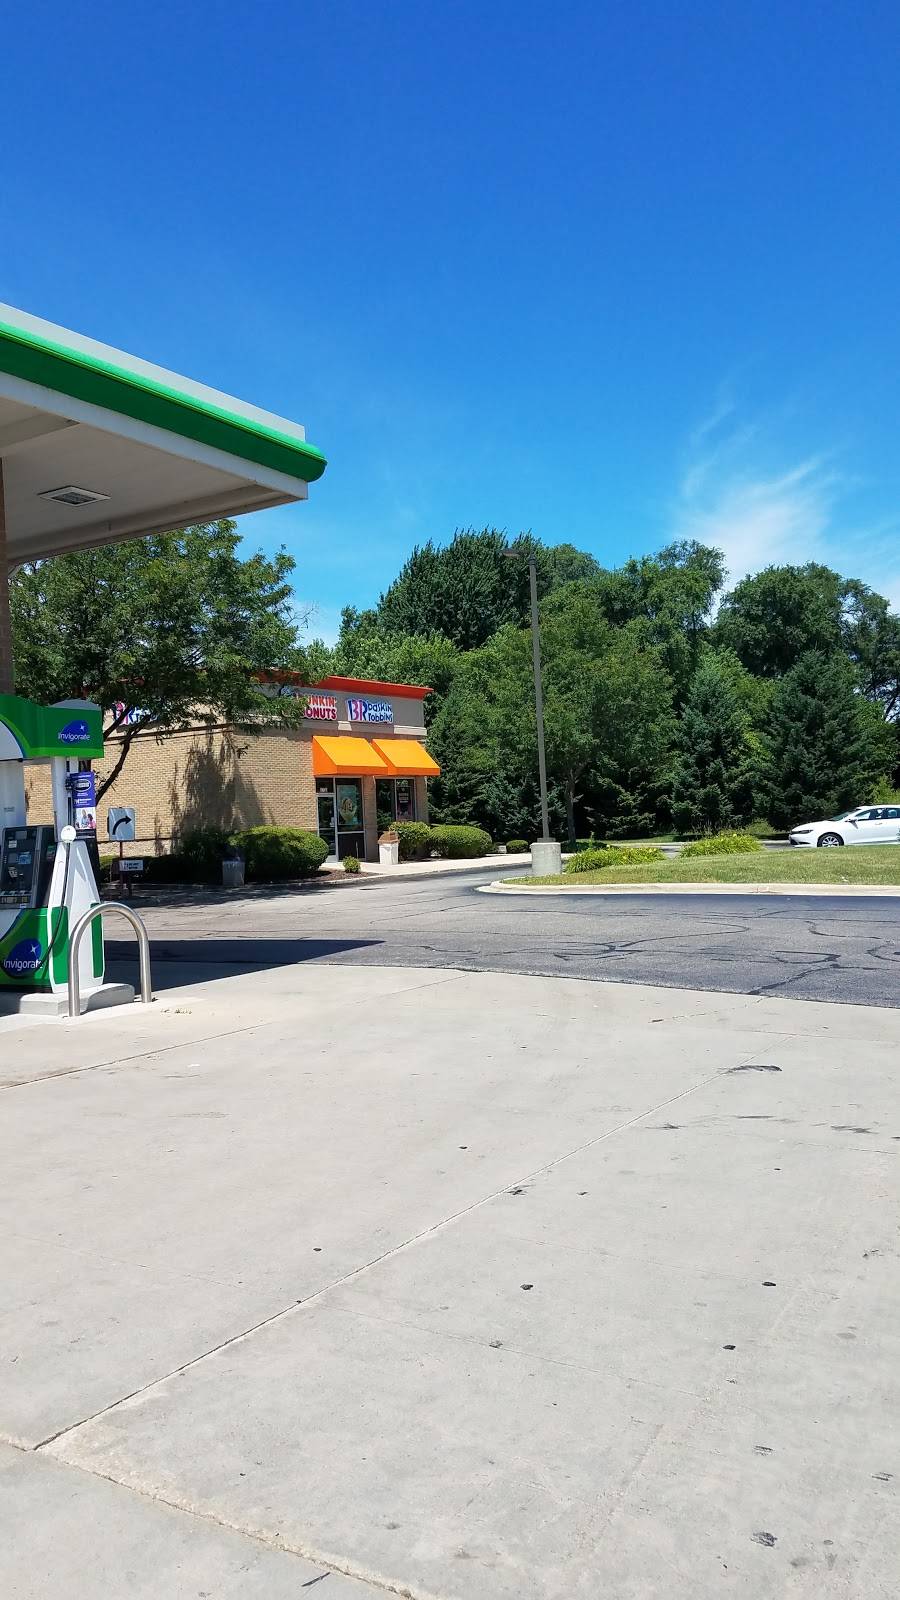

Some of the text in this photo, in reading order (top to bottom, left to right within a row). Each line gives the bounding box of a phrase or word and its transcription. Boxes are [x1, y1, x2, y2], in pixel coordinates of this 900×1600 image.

[303, 695, 337, 707] UNKIN'
[303, 707, 337, 719] ONUTS
[348, 698, 368, 721] BR
